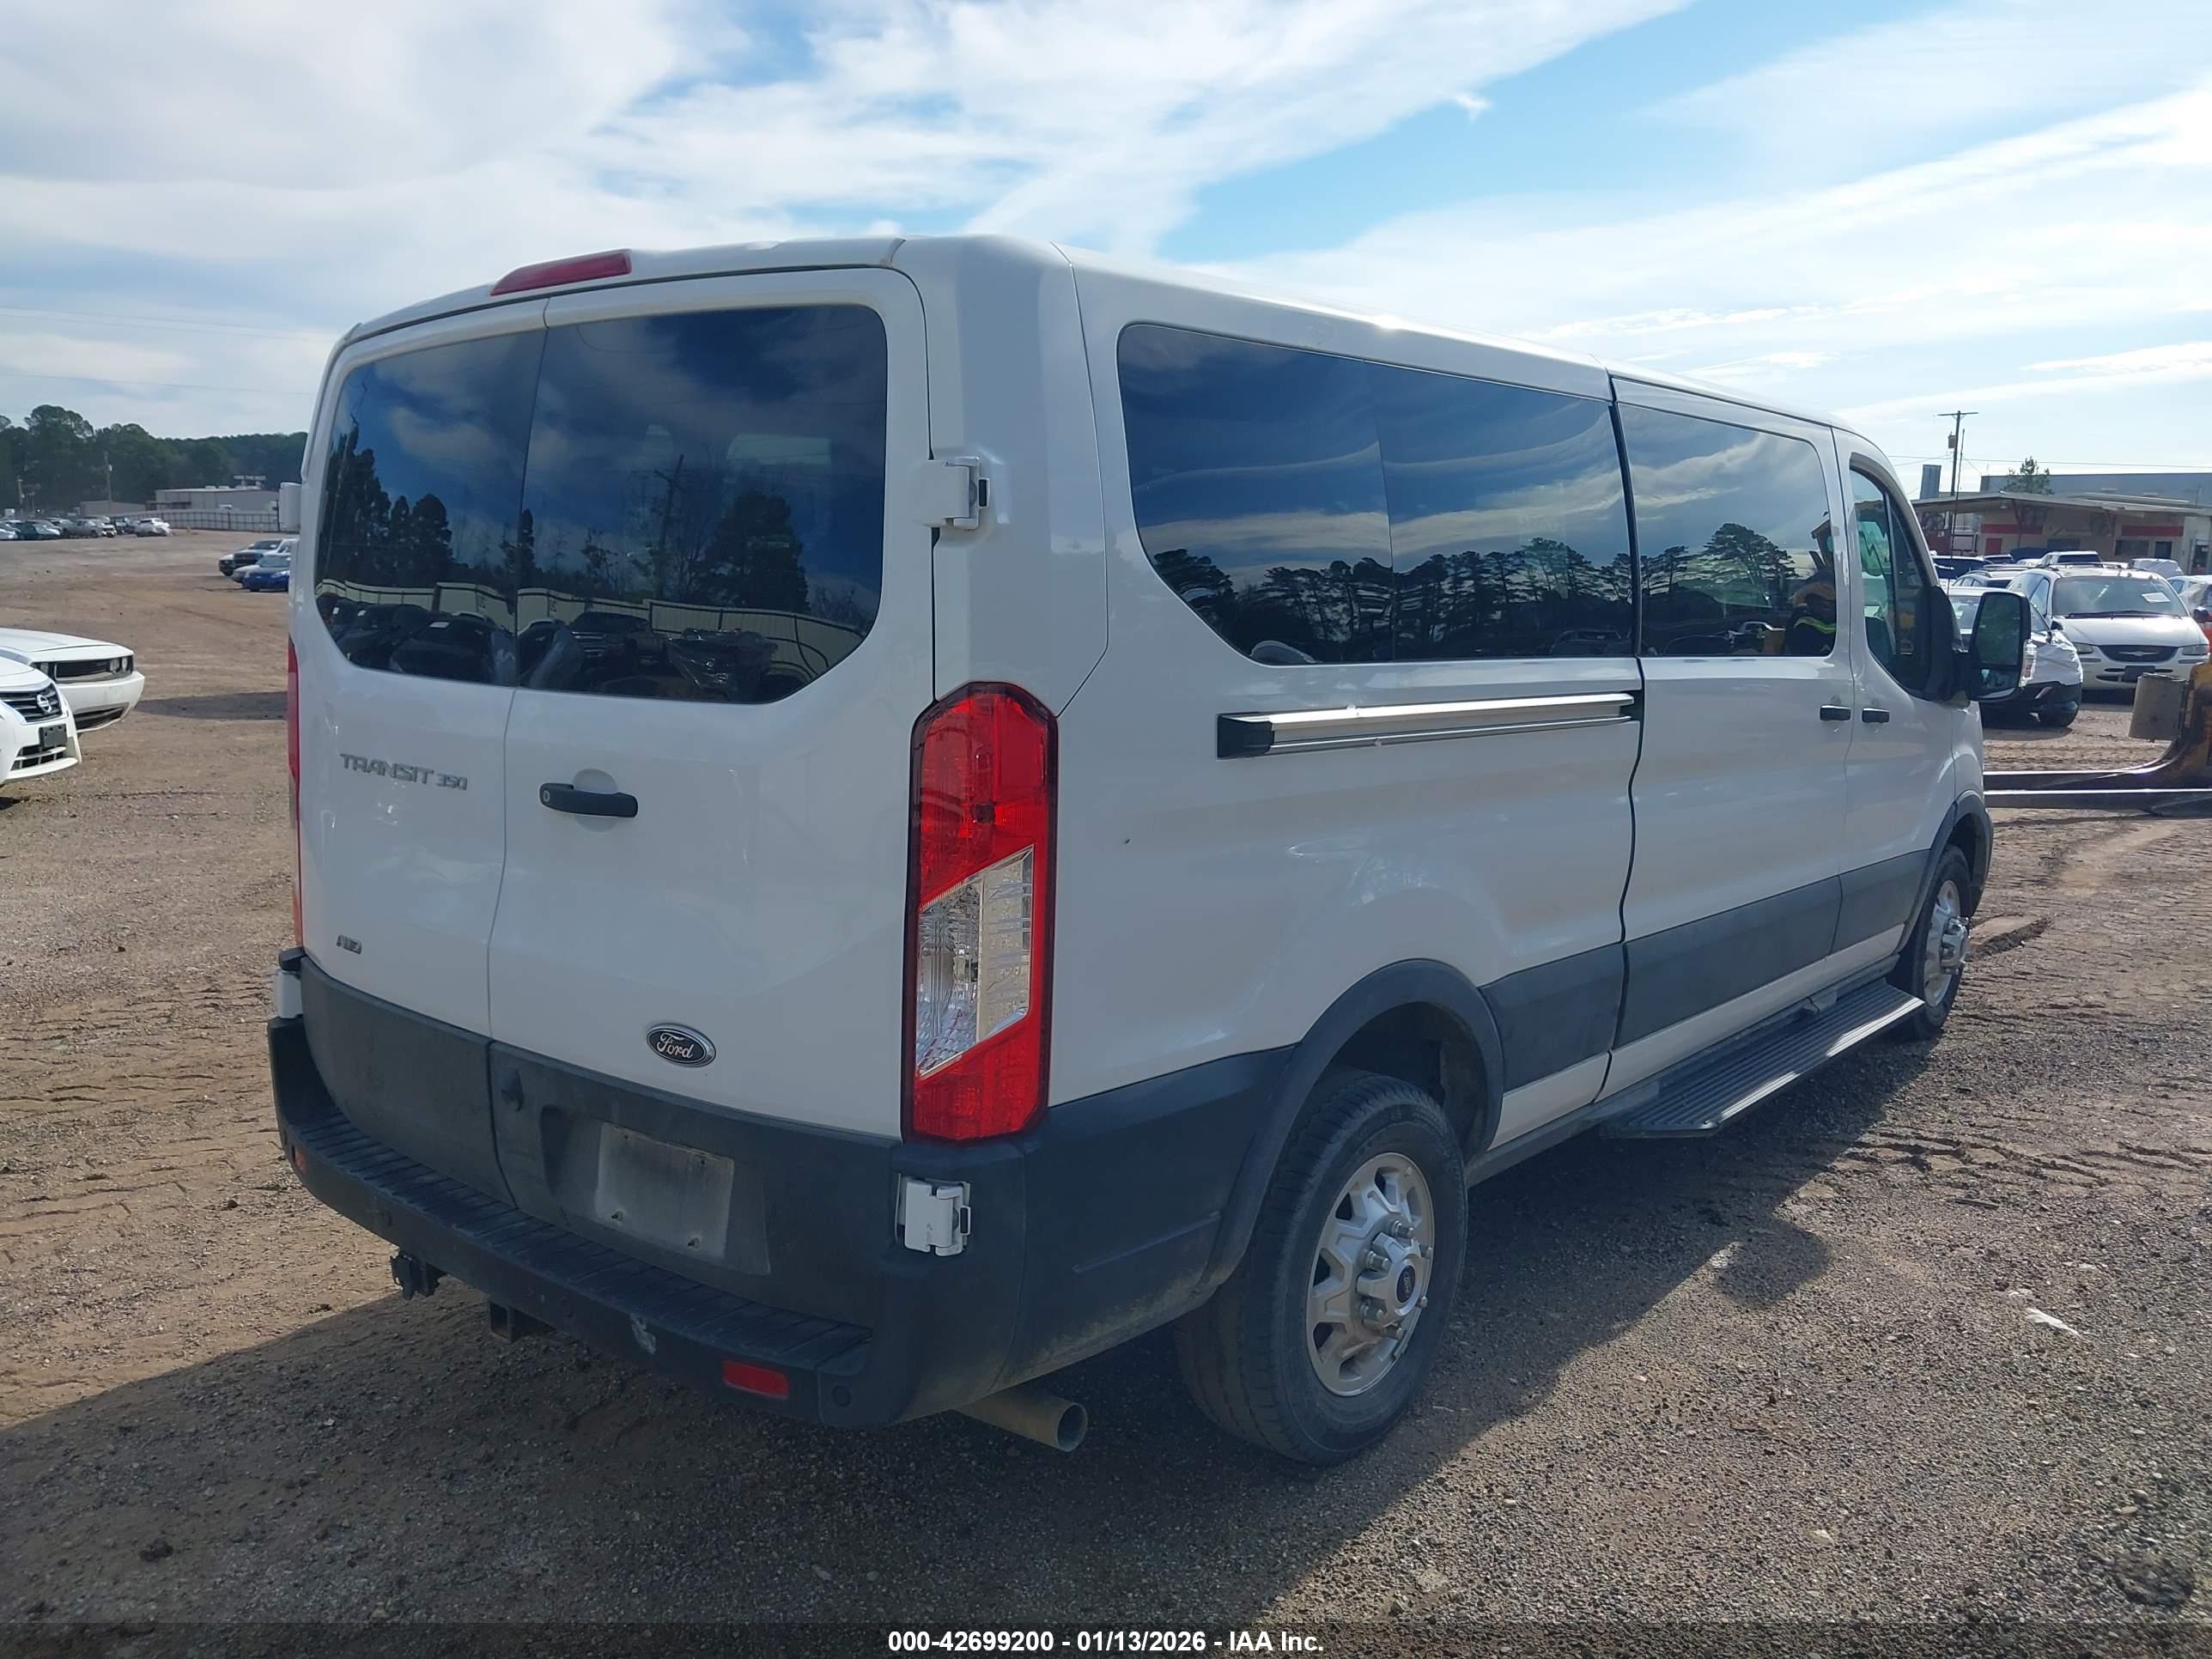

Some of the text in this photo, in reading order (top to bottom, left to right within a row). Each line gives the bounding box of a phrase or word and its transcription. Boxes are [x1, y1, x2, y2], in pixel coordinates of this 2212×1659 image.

[339, 752, 468, 791] TRANSIT 350
[656, 1032, 695, 1059] Ford
